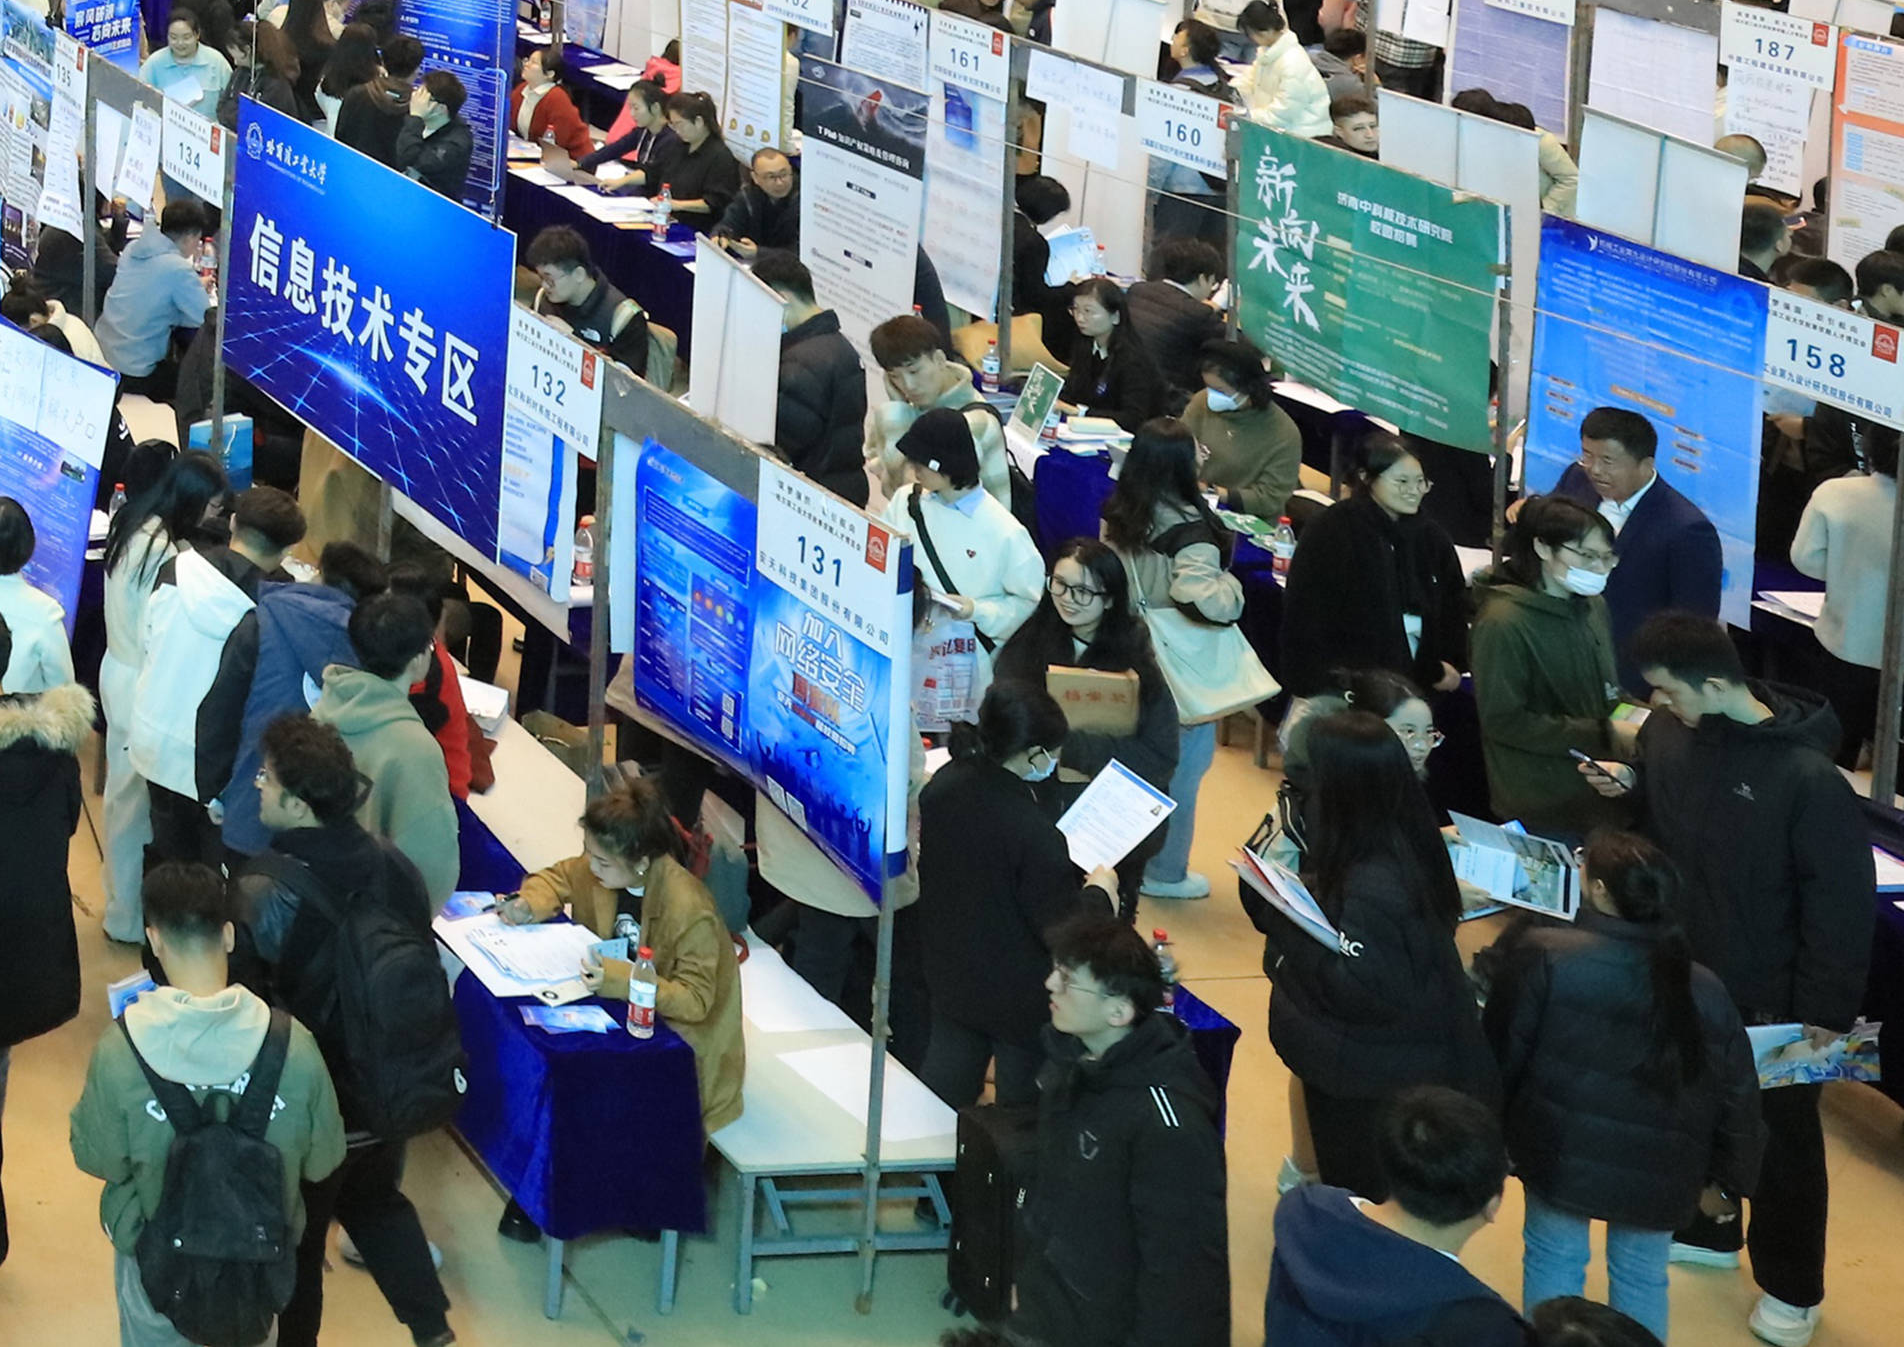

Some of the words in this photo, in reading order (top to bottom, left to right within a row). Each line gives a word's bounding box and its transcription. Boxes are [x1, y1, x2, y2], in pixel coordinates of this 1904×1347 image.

[950, 47, 979, 72] 161
[1755, 38, 1795, 61] 187
[57, 68, 71, 87] 135
[1165, 119, 1201, 147] 160
[179, 141, 201, 170] 134
[248, 212, 480, 426] 信息技术专区
[1787, 338, 1846, 378] 158
[531, 364, 566, 407] 132
[797, 535, 842, 587] 131
[759, 550, 890, 647] 安天科技集团股份有限公司
[776, 621, 867, 714] 网络安全
